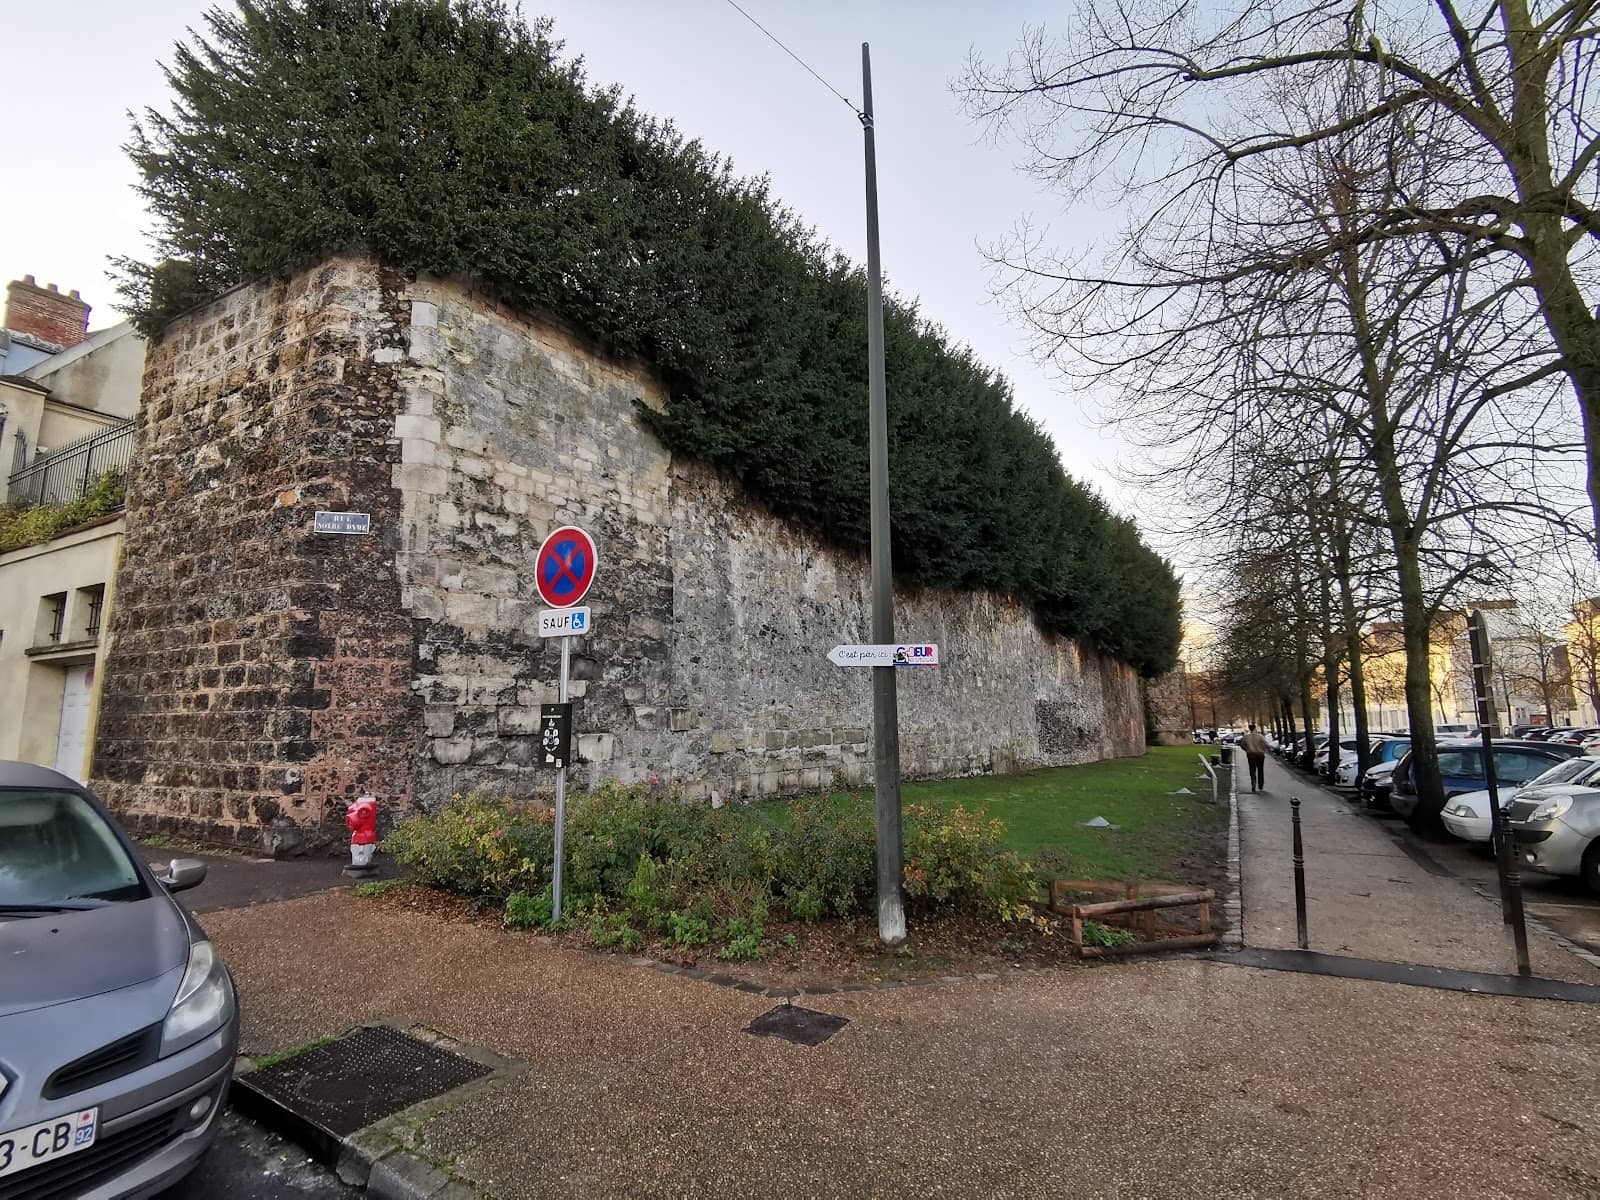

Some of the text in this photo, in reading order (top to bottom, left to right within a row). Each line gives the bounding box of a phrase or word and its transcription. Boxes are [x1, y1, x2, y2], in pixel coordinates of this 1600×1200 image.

[543, 616, 569, 629] SAUF
[839, 650, 858, 658] C'est
[860, 652, 875, 660] par
[76, 1126, 92, 1143] 92
